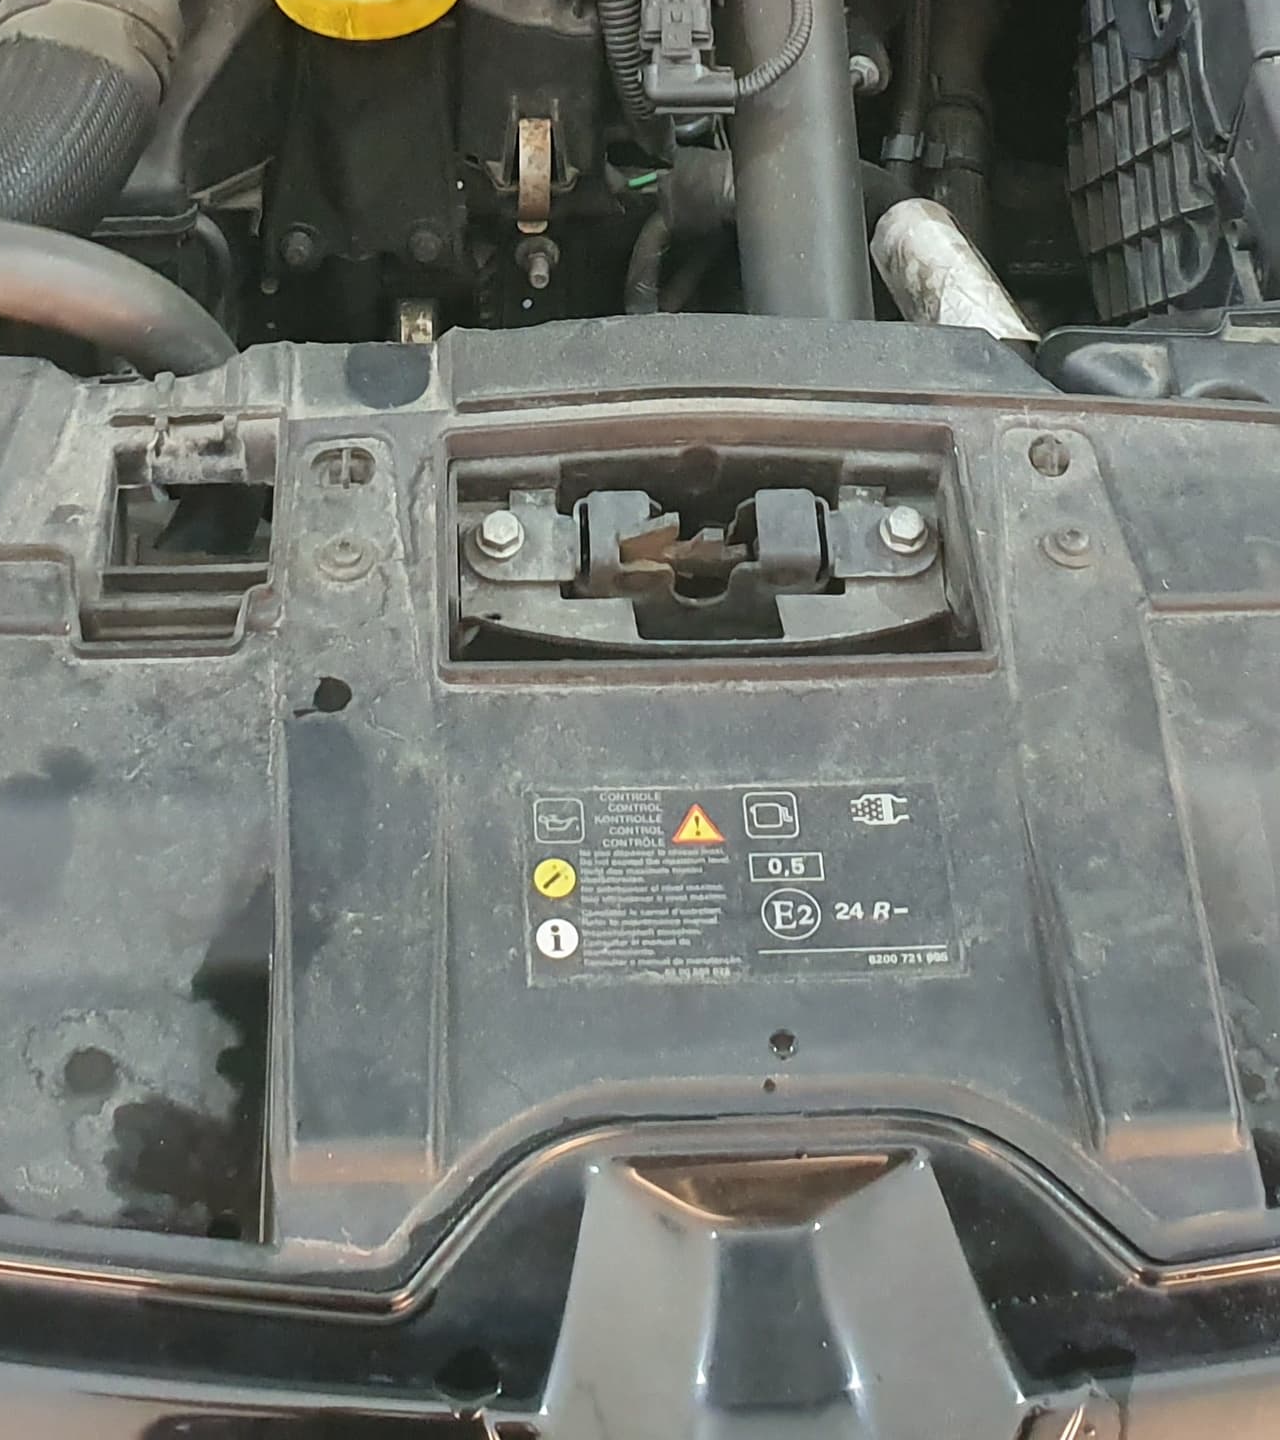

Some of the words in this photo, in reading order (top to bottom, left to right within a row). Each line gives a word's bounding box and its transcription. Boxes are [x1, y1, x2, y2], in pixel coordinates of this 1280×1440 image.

[608, 803, 663, 813] CONTROL
[609, 826, 664, 836] CONTROL
[768, 857, 805, 877] 0,5
[772, 900, 815, 930] E2
[834, 901, 864, 921] 24
